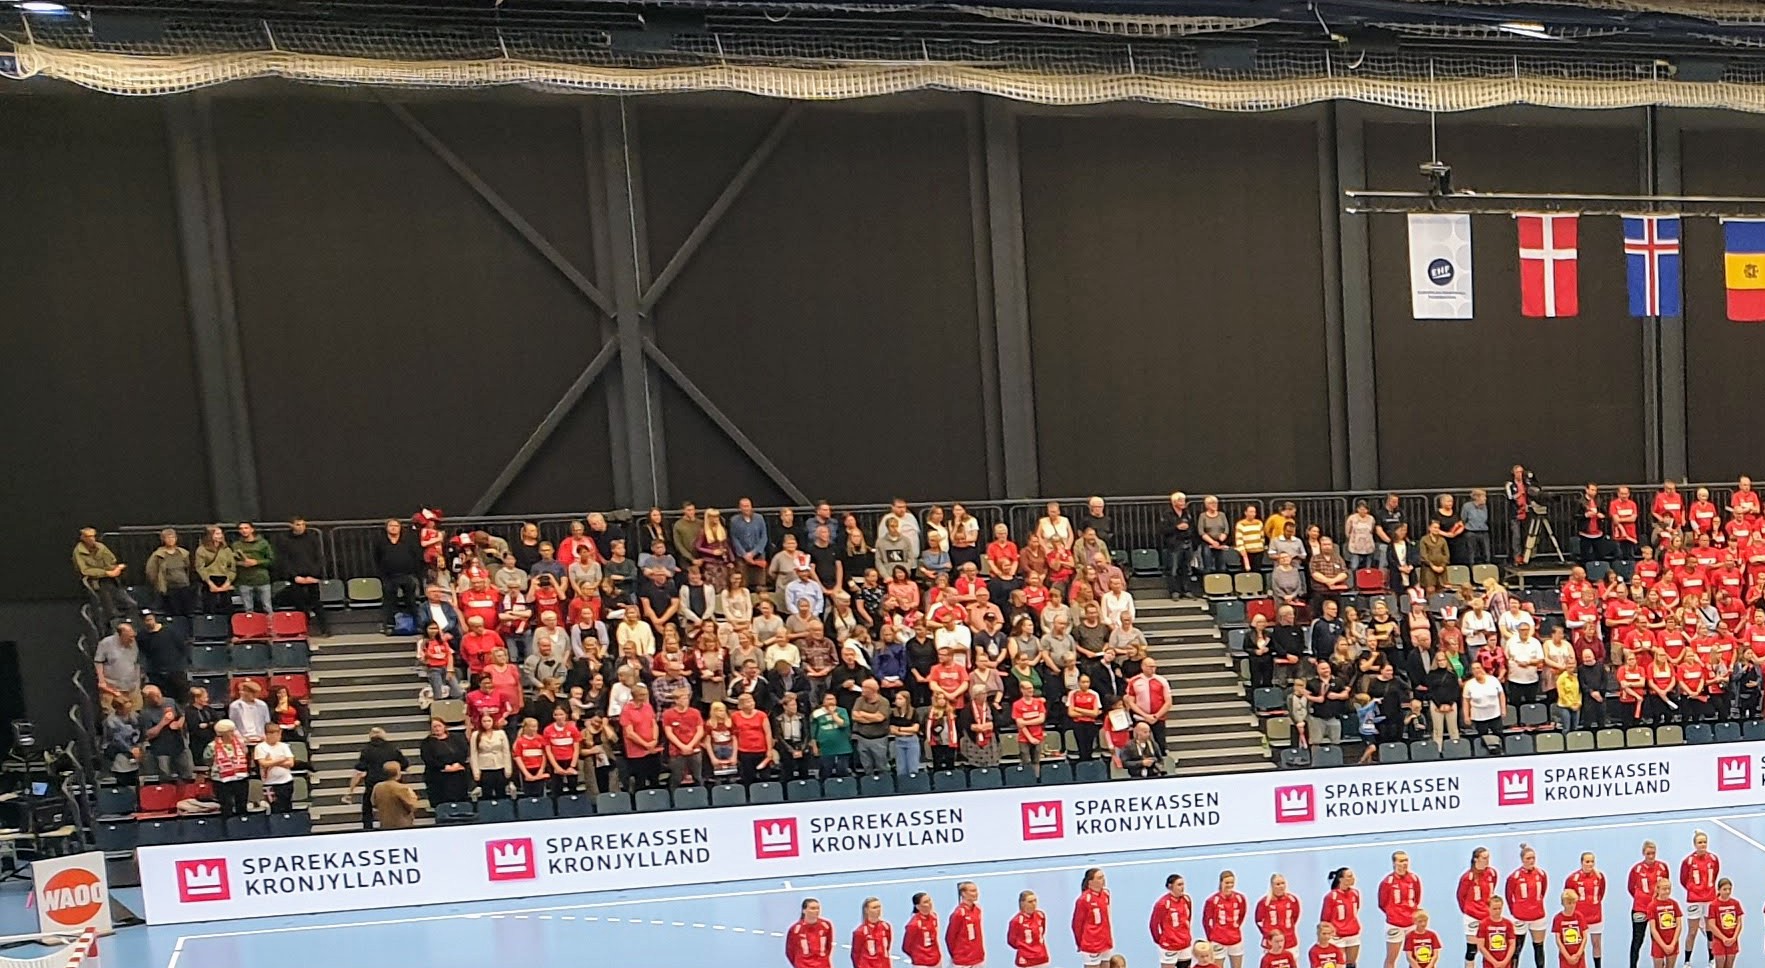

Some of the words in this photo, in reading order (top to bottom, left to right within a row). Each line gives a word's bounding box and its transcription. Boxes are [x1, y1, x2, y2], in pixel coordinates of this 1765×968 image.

[1430, 265, 1450, 277] EHF
[1544, 761, 1670, 784] SPAREKASSEN
[1324, 776, 1459, 800] SPAREKASSEN
[1545, 779, 1670, 801] KRONJYLLAND
[1074, 791, 1219, 816] SPAREKASSEN
[1326, 794, 1461, 818] KRONJYLLAND
[810, 808, 963, 834] SPAREKASSEN
[1076, 810, 1220, 835] KRONJYLLAND
[546, 827, 708, 854] SPAREKASSEN
[812, 827, 964, 853] KRONJYLLAND
[242, 847, 418, 875] SPAREKASSEN
[548, 847, 710, 875] KRONJYLLAND
[245, 868, 421, 896] KRONJYLLAND
[43, 881, 104, 911] WAOO
